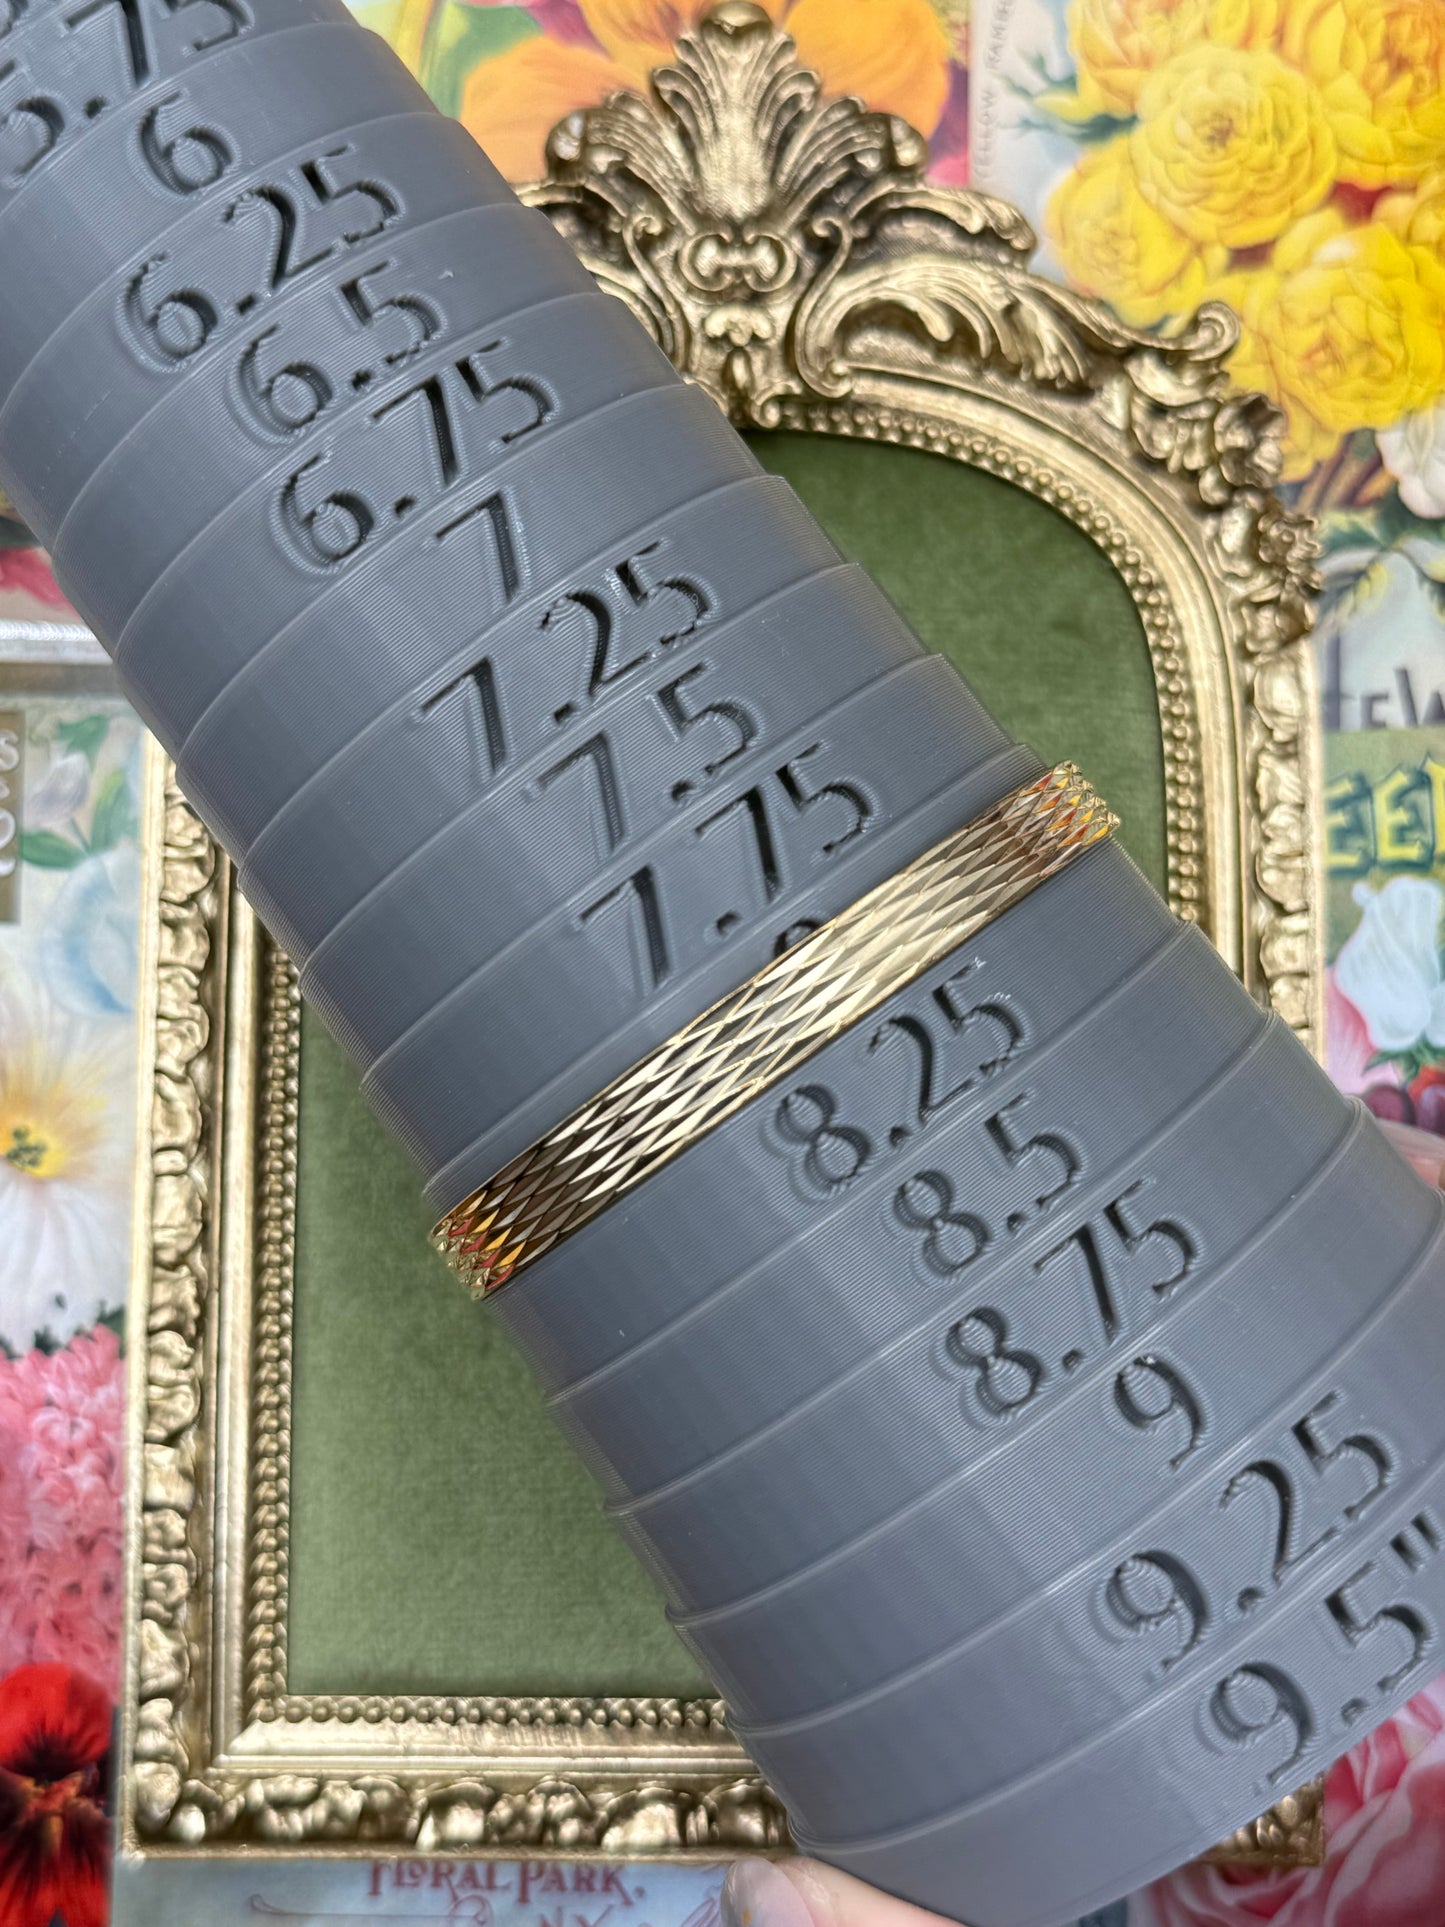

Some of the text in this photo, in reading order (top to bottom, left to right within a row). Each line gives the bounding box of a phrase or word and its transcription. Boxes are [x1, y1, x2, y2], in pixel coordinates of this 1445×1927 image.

[118, 143, 405, 372] 6.25
[132, 89, 239, 197] 6
[230, 258, 447, 444] 6.5
[273, 337, 558, 574] 6.75
[414, 537, 717, 780] 7.25
[428, 486, 530, 602] 7
[530, 659, 764, 856] 7.5
[573, 739, 880, 990] 7.75
[766, 957, 1031, 1196] 8.25
[885, 1092, 1088, 1282] 8.5
[936, 1176, 1203, 1424] 8.75
[1109, 1353, 1208, 1471] 9
[1096, 1390, 1397, 1674] 9.25
